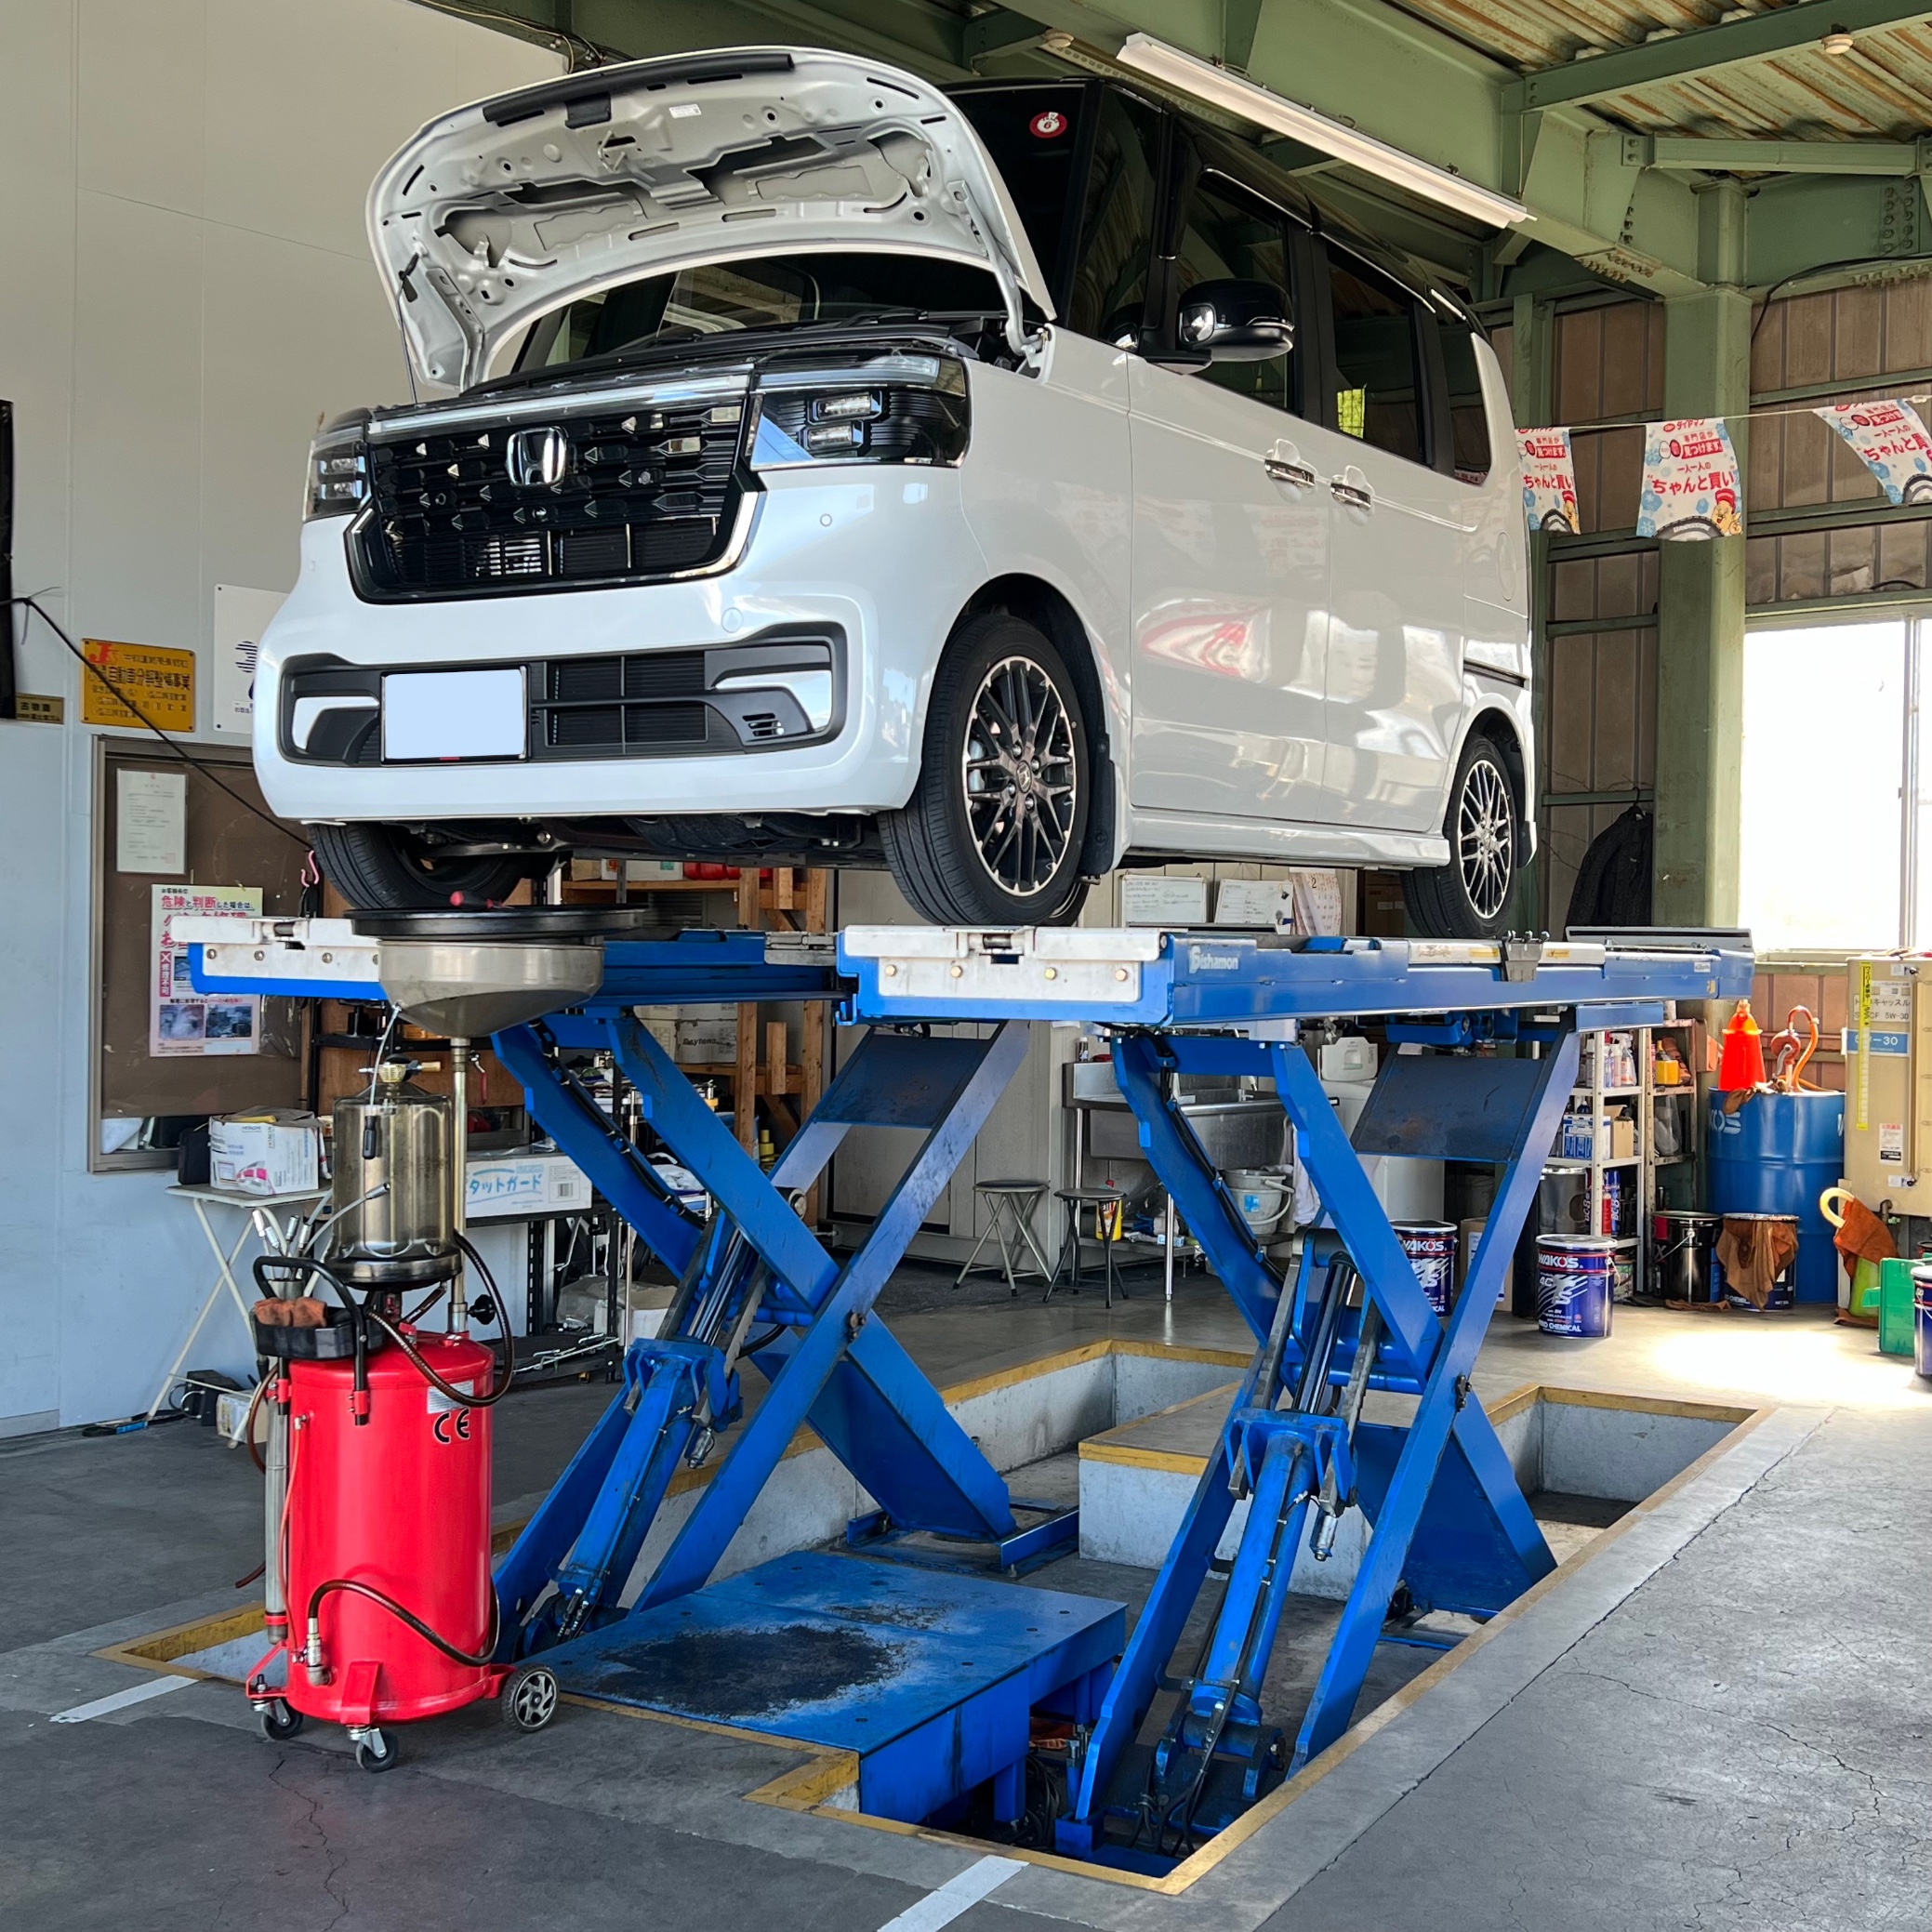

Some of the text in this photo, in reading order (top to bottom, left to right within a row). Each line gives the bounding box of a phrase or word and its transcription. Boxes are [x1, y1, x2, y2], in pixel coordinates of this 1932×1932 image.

[1677, 461, 1712, 473] 一人一人の
[1311, 877, 1317, 889] 2
[466, 1173, 543, 1195] タットガード
[433, 1407, 470, 1444] CE
